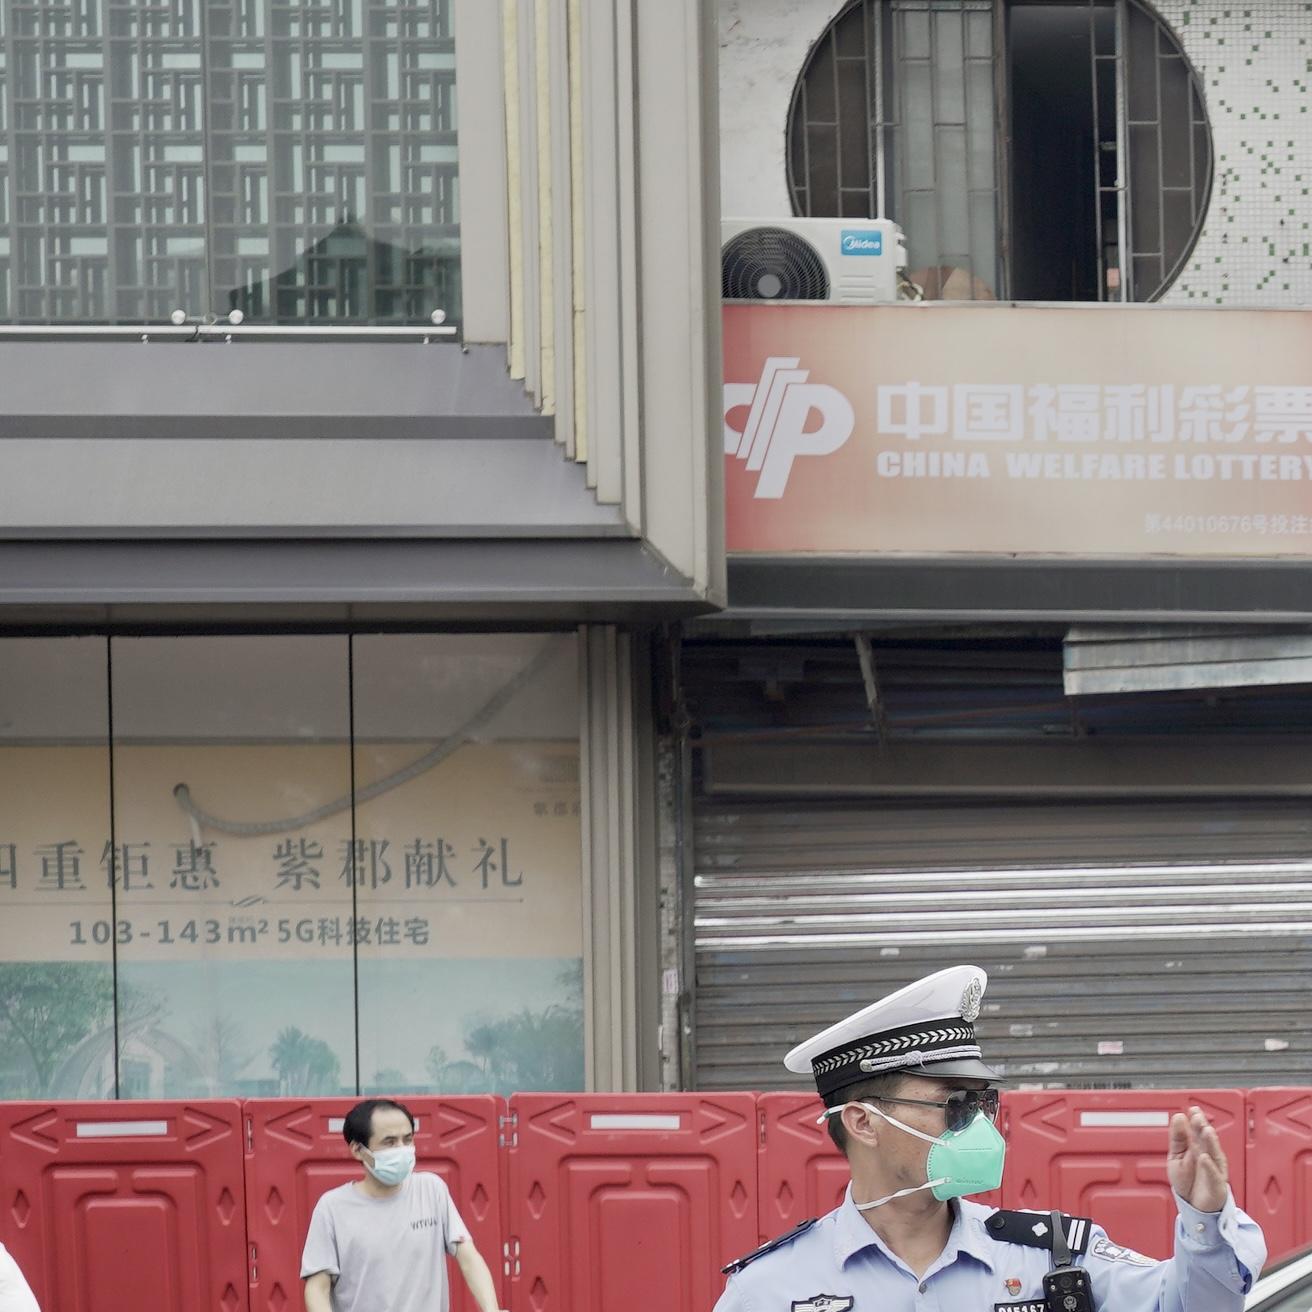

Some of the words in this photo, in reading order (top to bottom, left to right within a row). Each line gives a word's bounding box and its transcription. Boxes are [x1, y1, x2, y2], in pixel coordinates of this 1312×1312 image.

[877, 451, 990, 478] CHINA
[1006, 452, 1166, 479] WELFARE
[273, 836, 524, 891] 紫郡献礼
